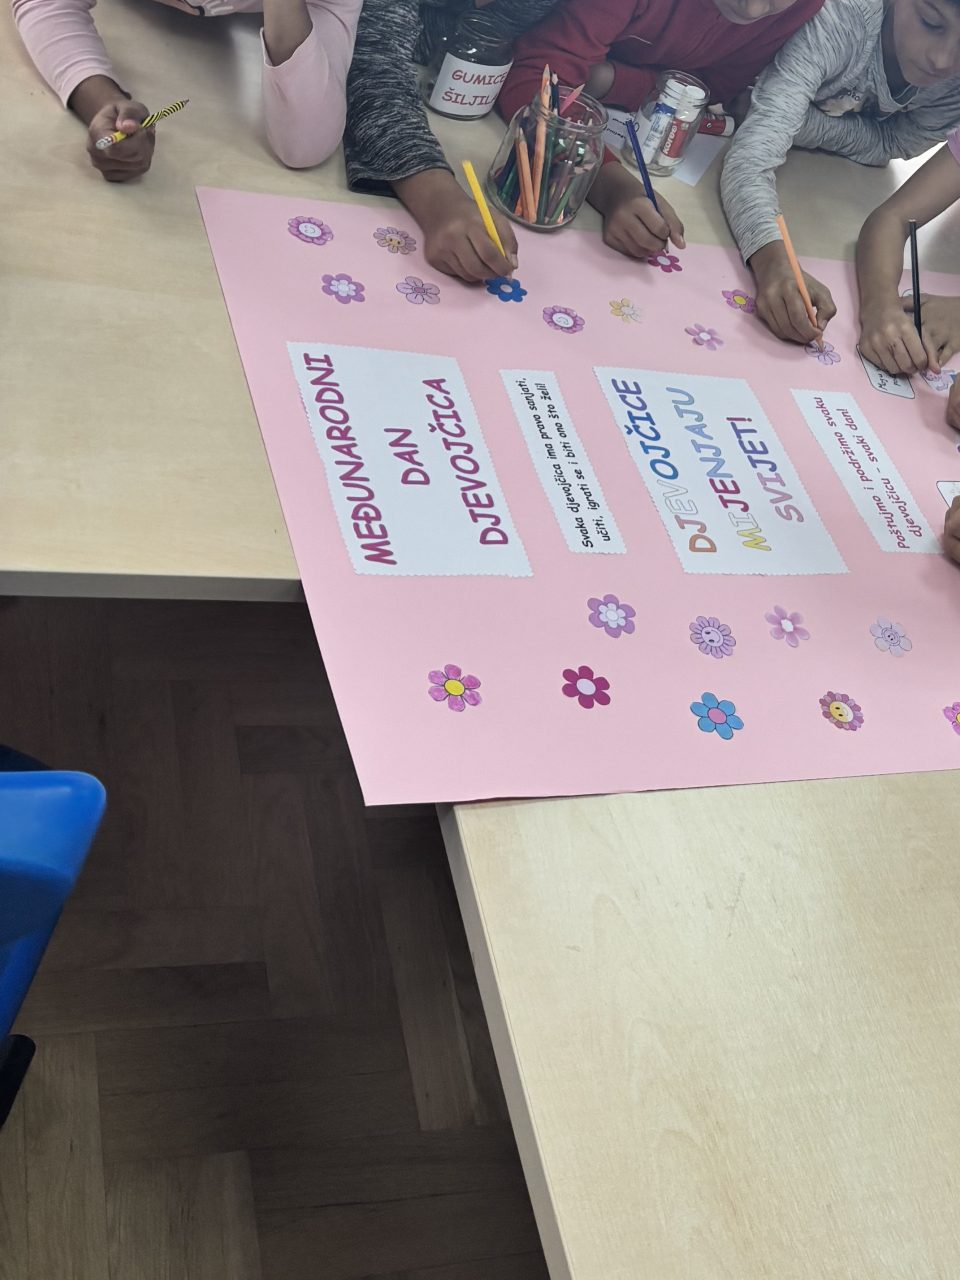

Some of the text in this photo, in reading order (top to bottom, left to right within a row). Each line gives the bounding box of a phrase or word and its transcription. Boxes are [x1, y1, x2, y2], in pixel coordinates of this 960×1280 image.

[534, 382, 552, 402] želi!
[546, 403, 560, 420] što
[813, 396, 837, 427] svaku
[554, 422, 567, 439] ono
[836, 408, 858, 431] dan!
[303, 352, 398, 566] MEĐUNARODNI
[383, 427, 431, 486] DAN
[422, 377, 509, 545] DJEVOJČICA
[515, 377, 594, 548] Svaka djevojčica ima pravo sanjati,
[559, 441, 576, 458] biti
[611, 378, 717, 553] DJEVOJČICE
[665, 386, 772, 552] MIJENJAJU
[833, 431, 873, 483] podržimo
[851, 434, 879, 463] svaki
[574, 468, 585, 481] se
[726, 416, 805, 523] SVIJET!
[577, 483, 600, 510] igrati
[881, 477, 923, 538] djevojčicu
[592, 515, 611, 542] učiti,
[872, 495, 911, 549] Poštujmo
